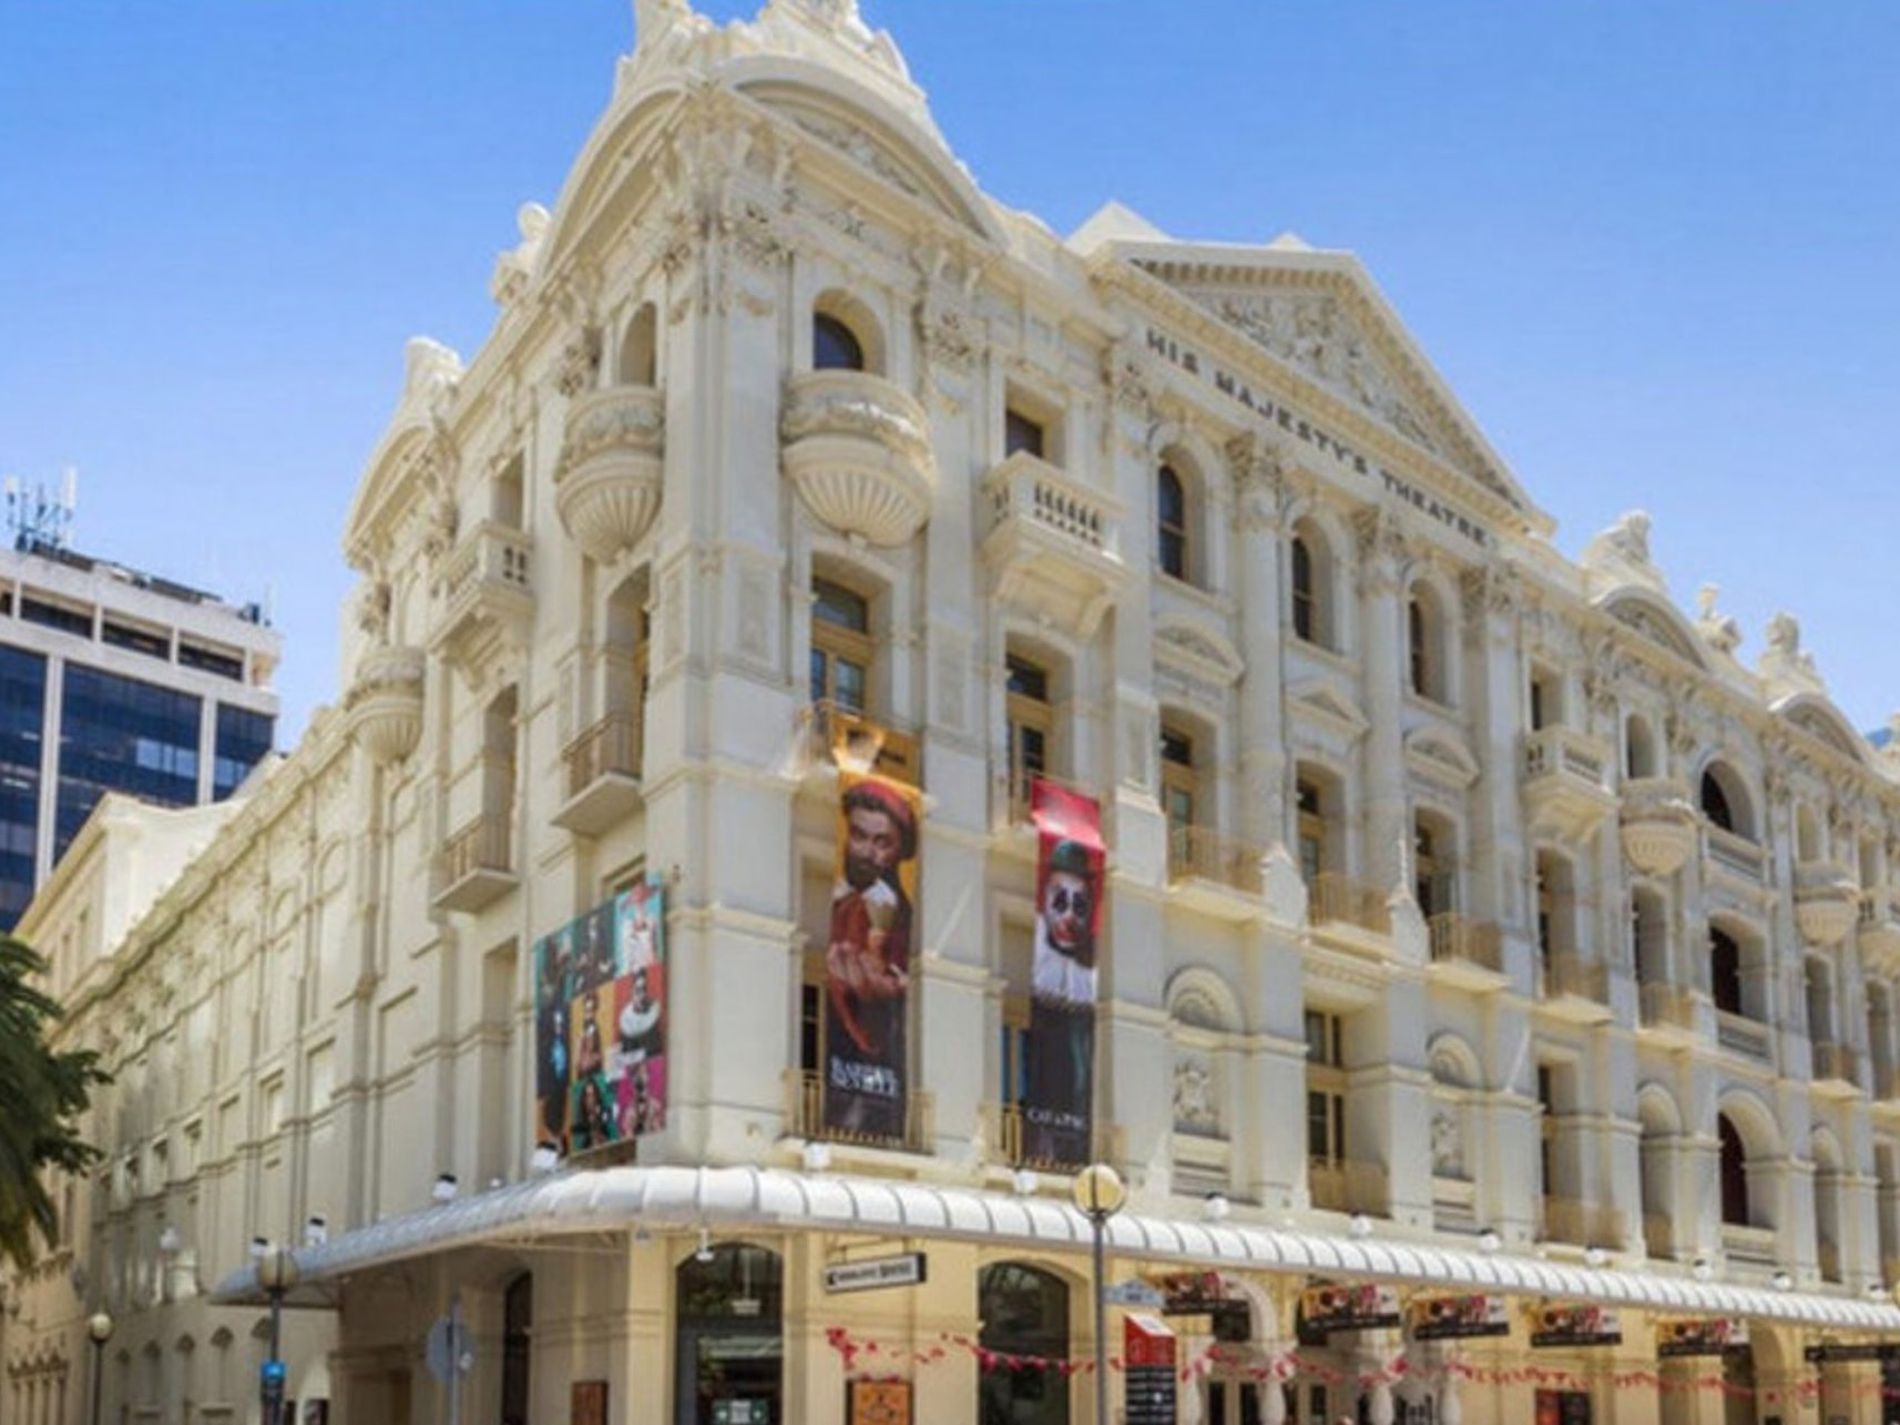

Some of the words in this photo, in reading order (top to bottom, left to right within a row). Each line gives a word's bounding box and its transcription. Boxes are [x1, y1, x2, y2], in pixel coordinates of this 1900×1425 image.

[1147, 328, 1199, 374] HIS
[1216, 370, 1369, 475] MAJESTY'S
[1379, 468, 1487, 546] THEATRE
